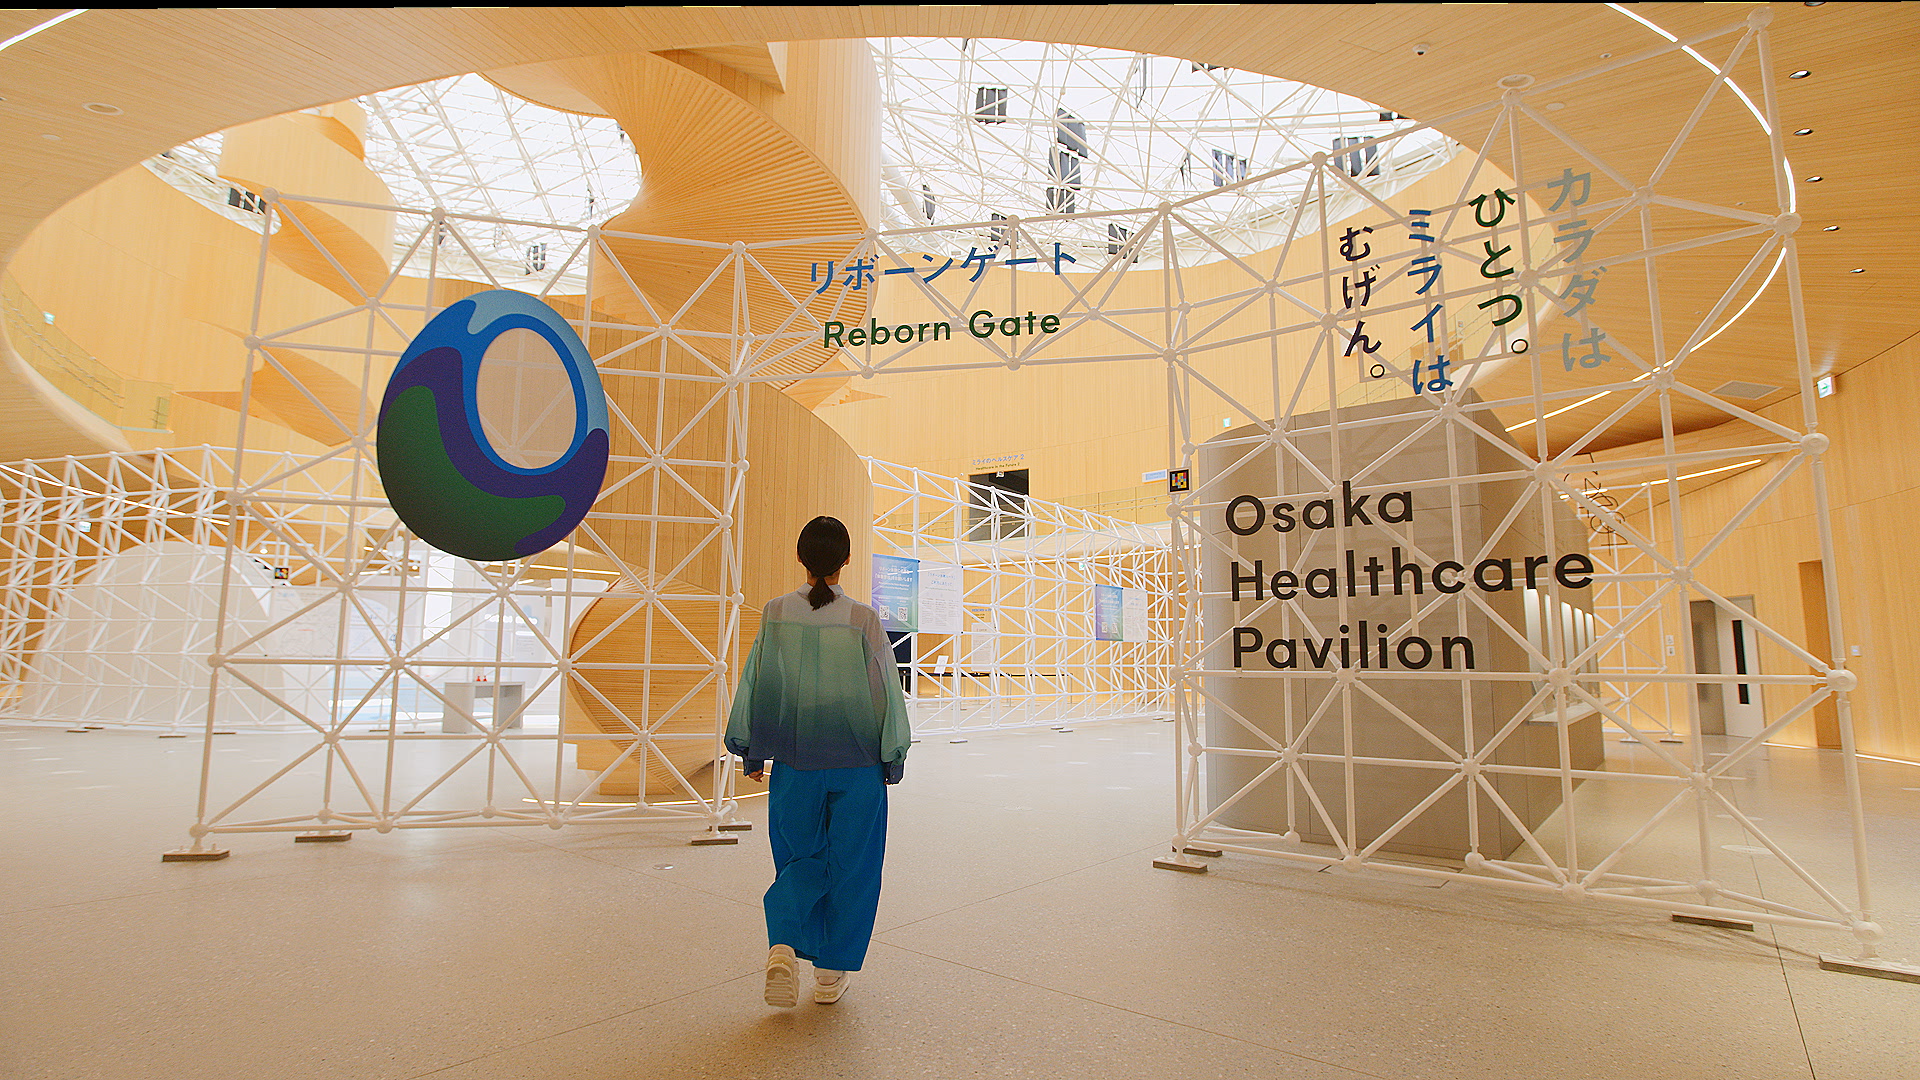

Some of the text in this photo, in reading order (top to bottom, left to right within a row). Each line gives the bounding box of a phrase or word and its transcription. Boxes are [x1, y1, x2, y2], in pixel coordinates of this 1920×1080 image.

[811, 242, 1076, 294] リボーンゲート
[1468, 188, 1528, 354] ひとつ。
[1547, 168, 1611, 372] カラダは
[823, 310, 1060, 348] Reborn Gate
[1339, 226, 1385, 378] むげん。
[1407, 209, 1453, 395] ミライは
[1225, 481, 1413, 536] Osaka
[1231, 547, 1594, 601] Healthcare
[1233, 621, 1475, 669] Pavilion
